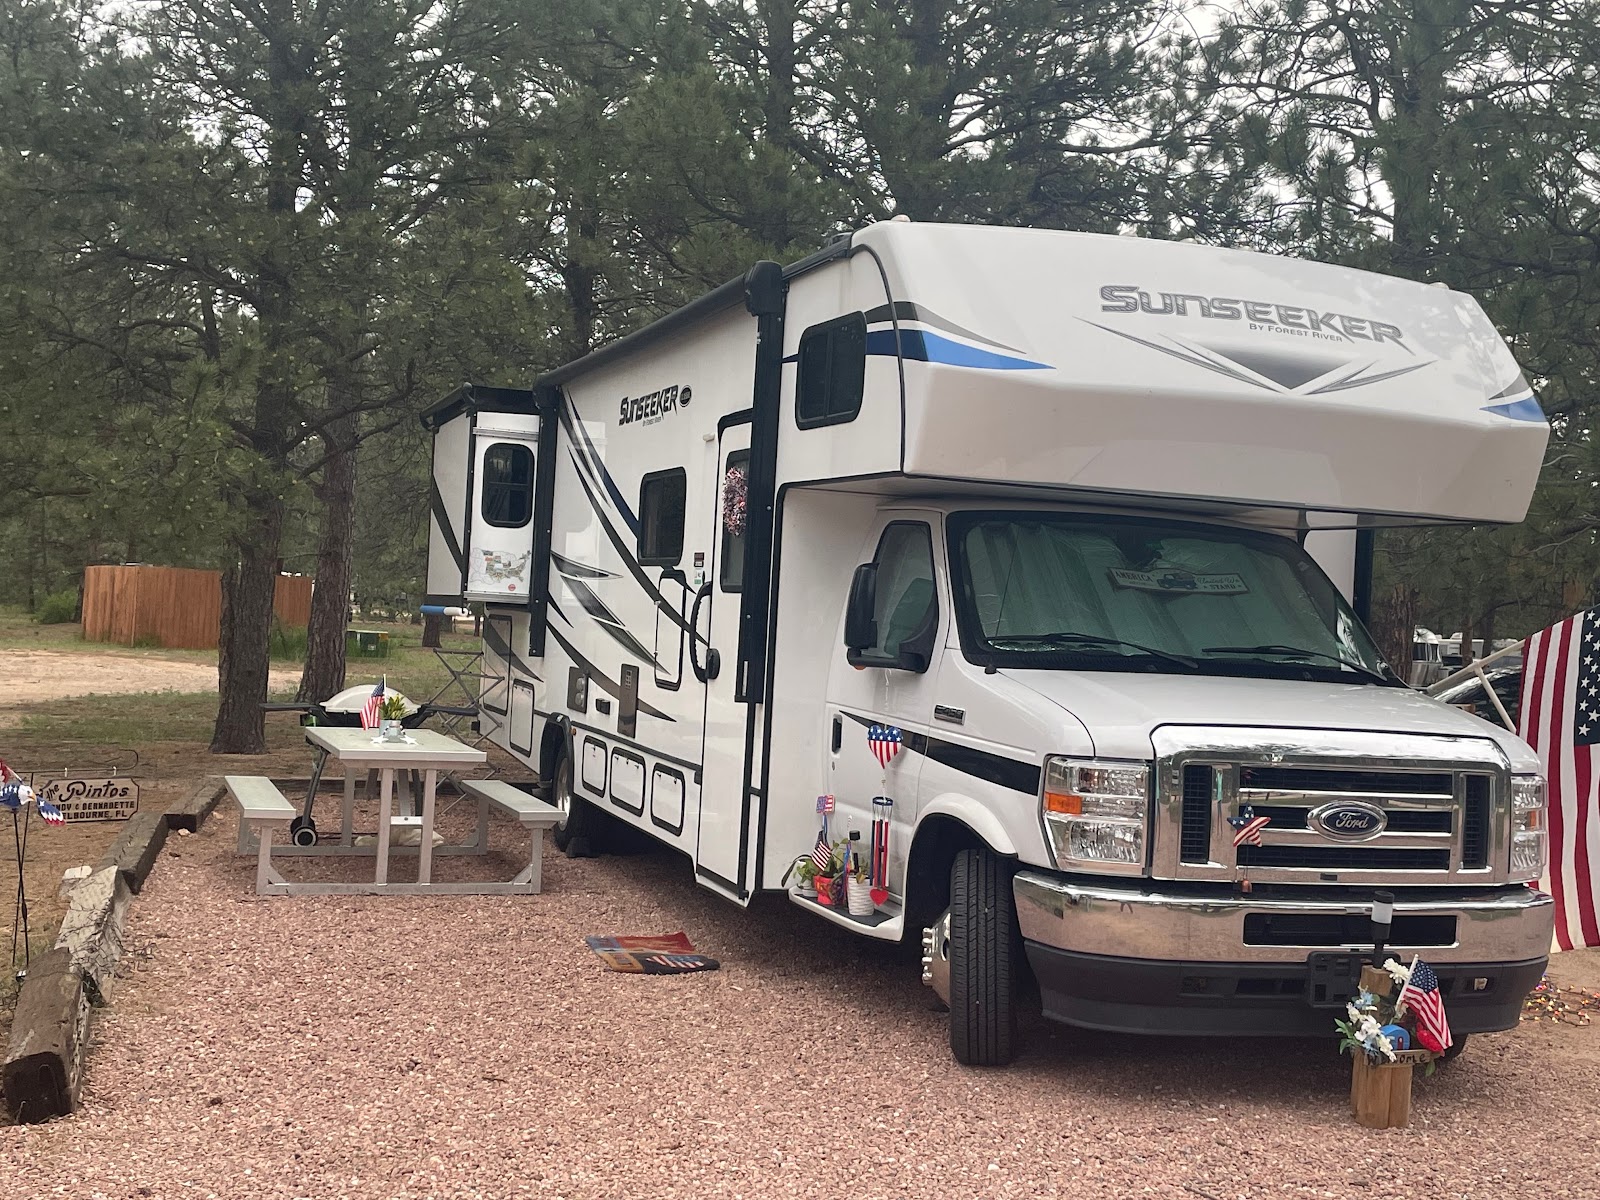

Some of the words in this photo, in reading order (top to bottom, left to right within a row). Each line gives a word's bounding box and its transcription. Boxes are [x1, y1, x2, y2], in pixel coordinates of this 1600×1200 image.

[1249, 323, 1264, 331] BY
[1268, 325, 1309, 337] FOREST
[1312, 331, 1343, 343] RIVER
[1115, 571, 1154, 583] AMERICA
[46, 784, 60, 801] the
[58, 780, 130, 802] Pintos
[53, 803, 72, 811] NDY
[82, 801, 135, 811] BERNADETTE
[62, 810, 113, 820] ELBOURNE,
[115, 810, 127, 818] FL
[1335, 811, 1370, 829] Ford
